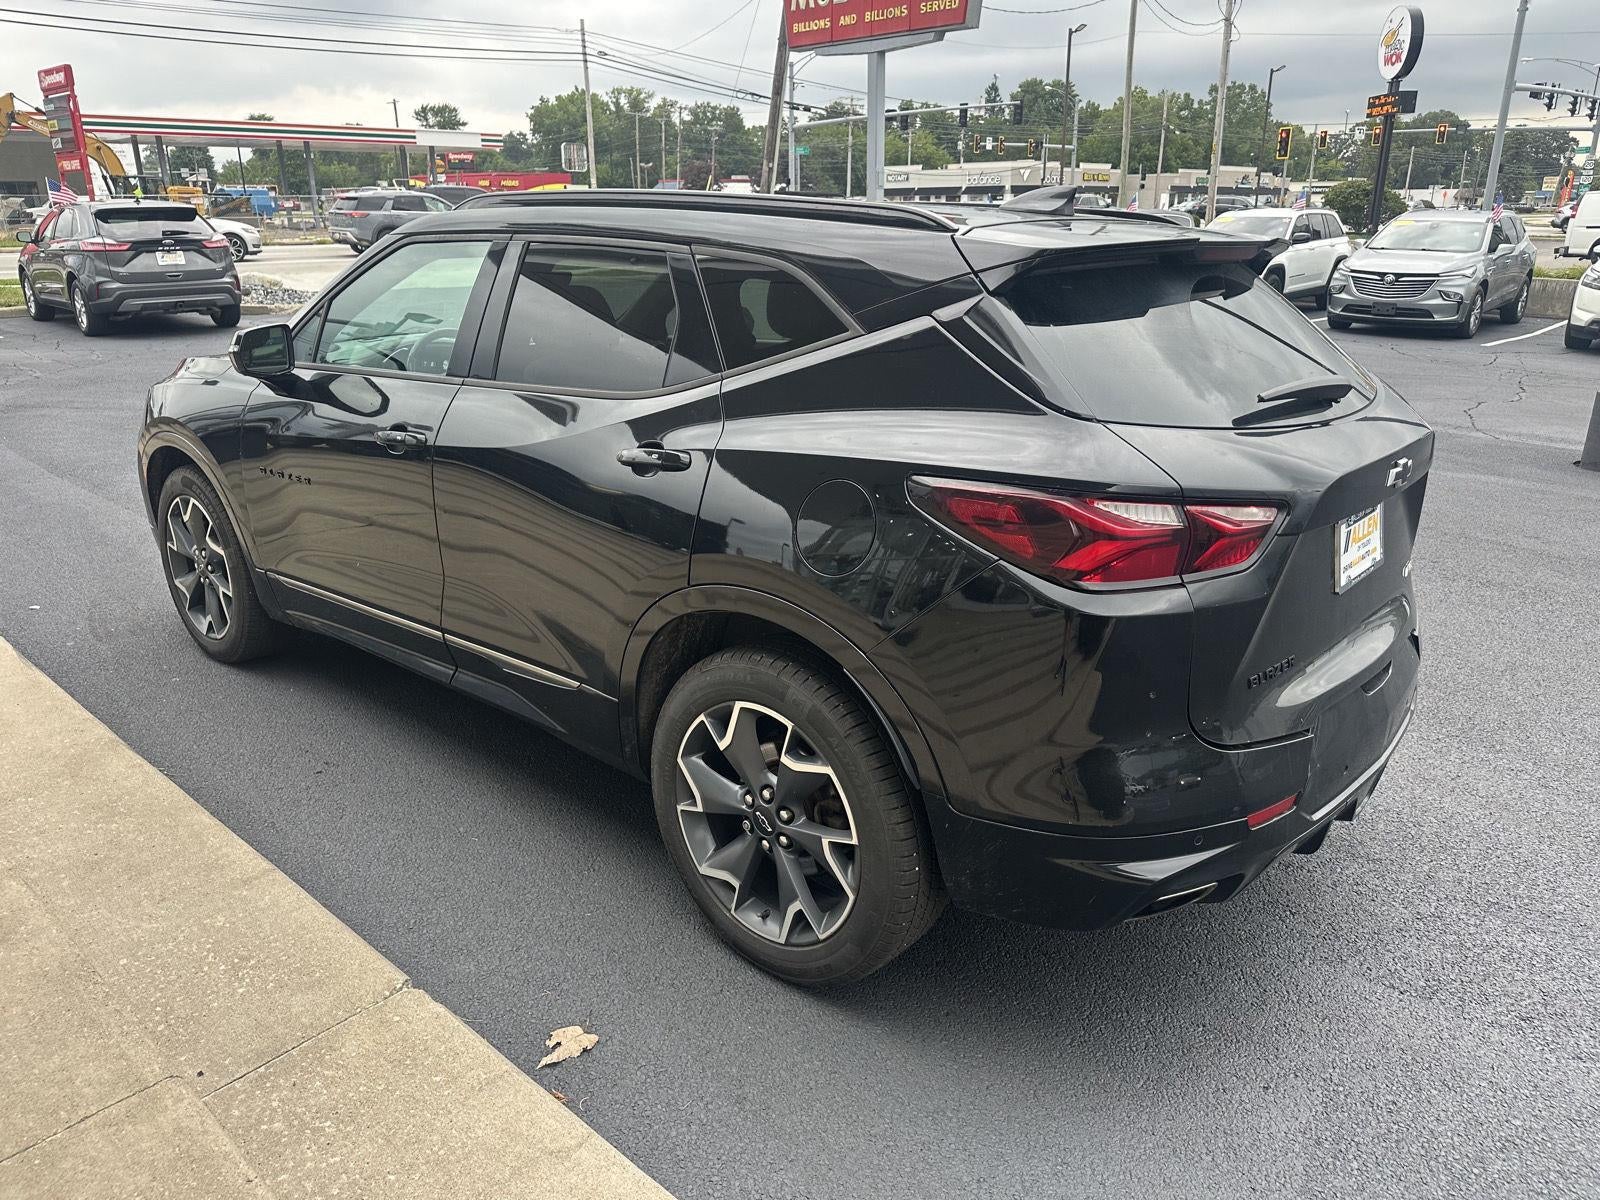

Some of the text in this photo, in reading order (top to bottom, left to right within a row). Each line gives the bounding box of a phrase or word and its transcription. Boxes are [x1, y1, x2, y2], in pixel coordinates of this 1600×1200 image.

[793, 18, 831, 33] BILLIONS
[839, 14, 857, 27] AND
[864, 5, 909, 22] BILLIONS
[920, 0, 960, 13] SERVED
[1384, 51, 1403, 66] WOK
[41, 70, 65, 89] Speedway
[448, 152, 474, 160] Speedway
[966, 170, 1001, 185] balance
[1351, 511, 1379, 547] ALLEN
[1246, 654, 1296, 689] BLAZER
